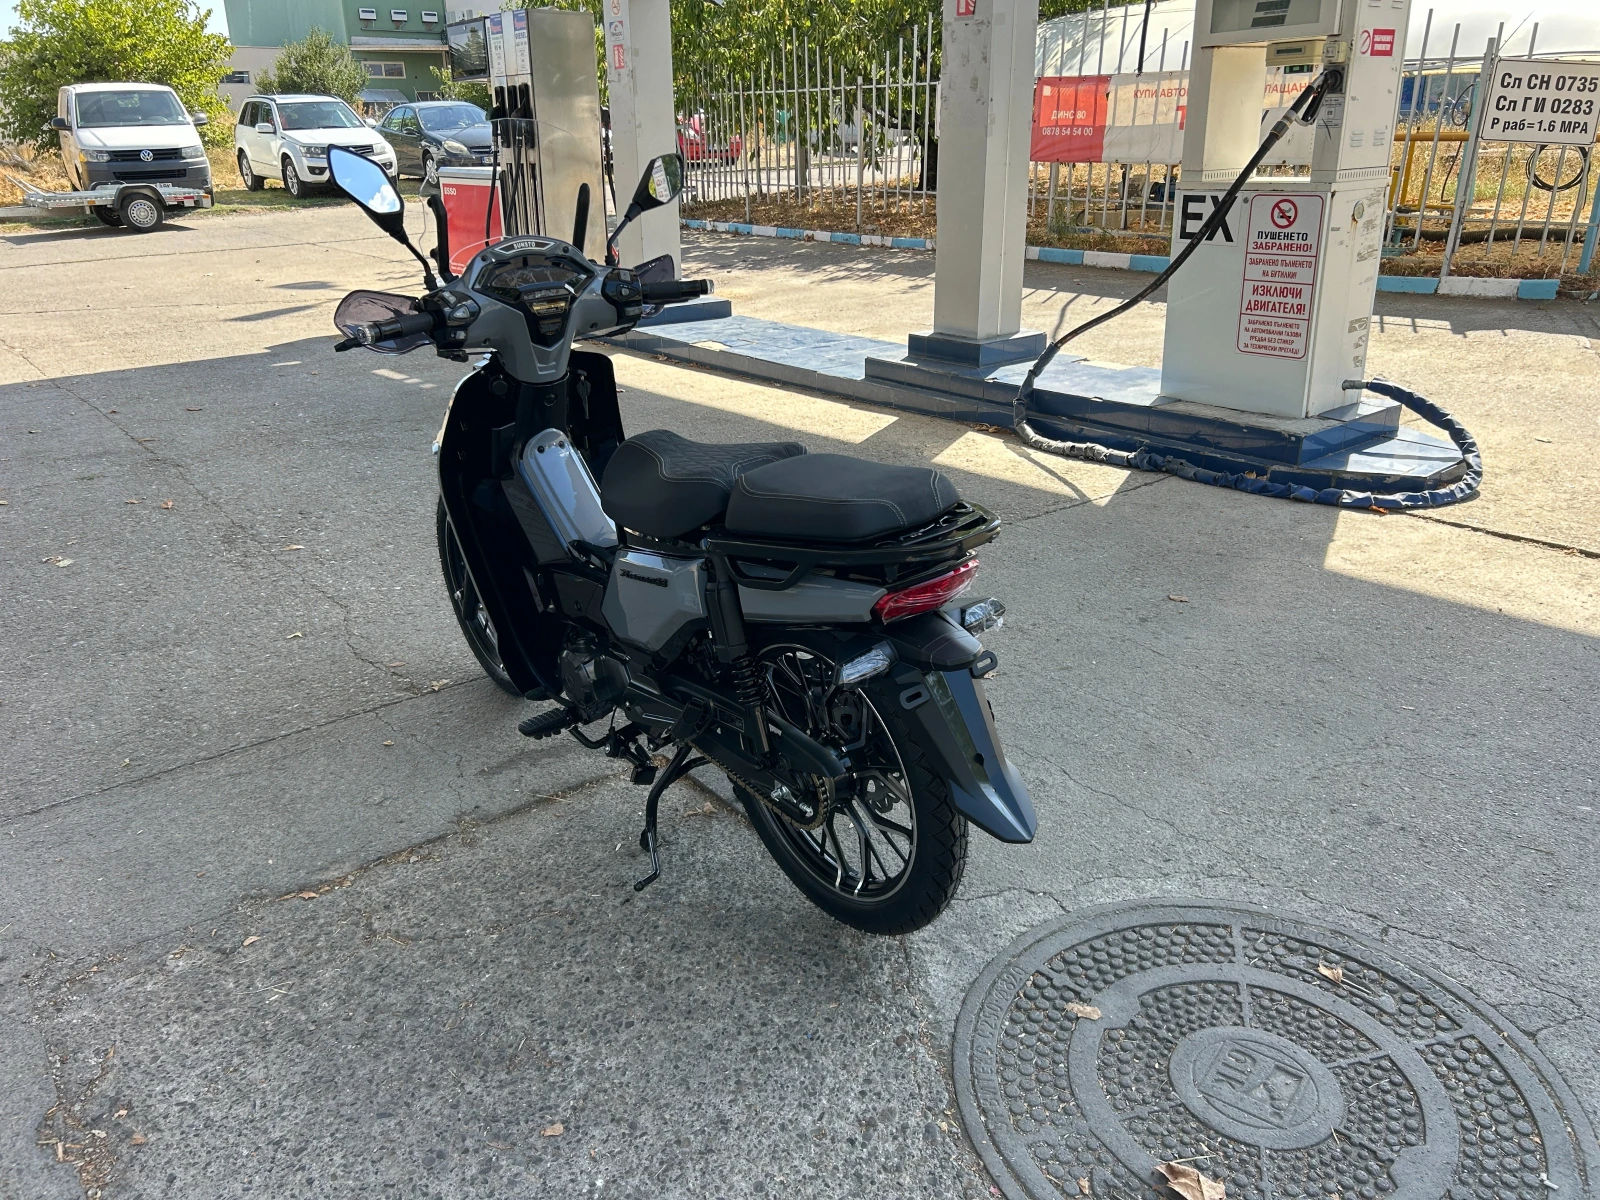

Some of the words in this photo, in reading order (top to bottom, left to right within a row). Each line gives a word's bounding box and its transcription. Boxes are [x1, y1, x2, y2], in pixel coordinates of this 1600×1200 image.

[1500, 72, 1522, 89] Сл
[1526, 73, 1551, 90] СН
[1554, 75, 1599, 93] 0735
[1133, 88, 1157, 98] КУПИ
[1160, 87, 1188, 98] АВТО
[1495, 95, 1518, 112] Сл
[1521, 96, 1547, 113] ГИ
[1550, 98, 1594, 115] 0283
[1076, 110, 1087, 120] 80
[1042, 127, 1060, 136] 0878
[1061, 127, 1072, 136] 54
[1073, 127, 1083, 136] 54
[1083, 127, 1093, 136] 00
[1490, 117, 1500, 130] P
[1559, 120, 1588, 134] MPA
[444, 187, 457, 196] ESSO
[1179, 194, 1238, 243] EX
[1257, 230, 1308, 242] ПУШЕНЕТО
[1252, 241, 1313, 253] ЗАБРАНЕНО!
[1248, 257, 1280, 267] ЗАБРАНЕНО
[1280, 259, 1313, 269] ПЪЛНЕНЕТО
[1262, 269, 1269, 277] НА
[1270, 270, 1298, 279] БУТИЛКИ!
[1252, 284, 1303, 300] ИЗКЛЮЧИ
[1245, 299, 1306, 316] ДВИГАТЕЛЯ!
